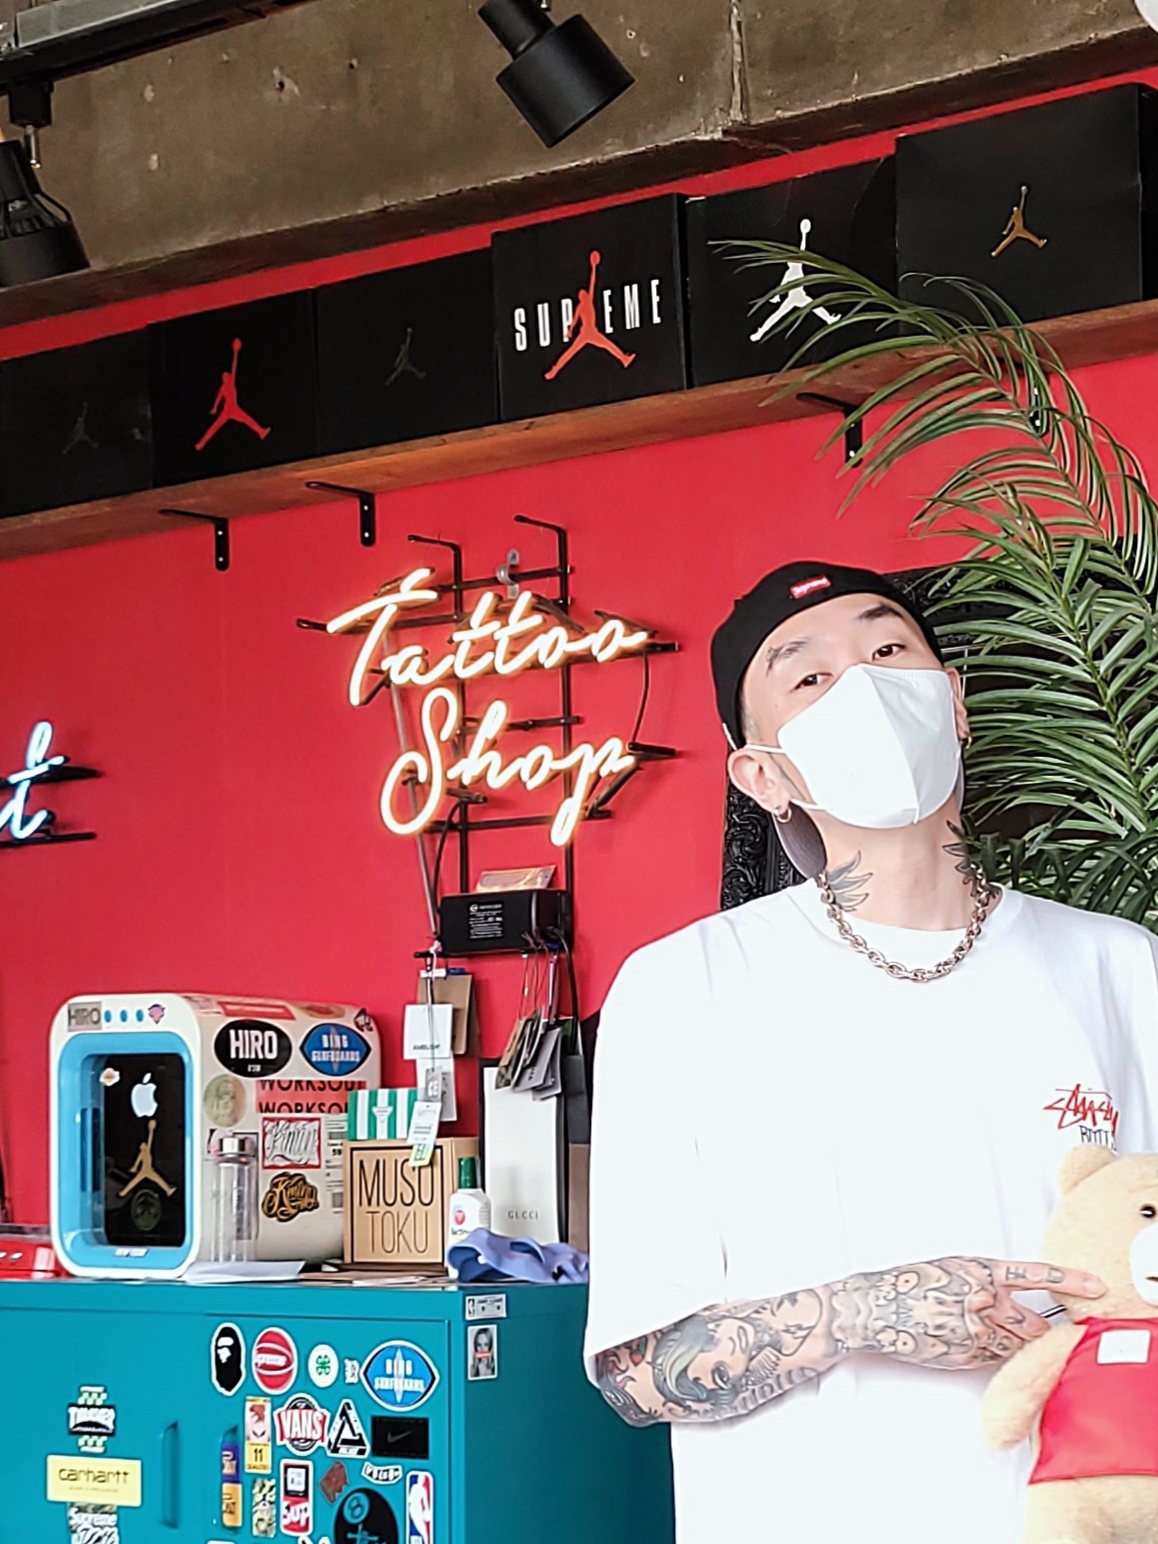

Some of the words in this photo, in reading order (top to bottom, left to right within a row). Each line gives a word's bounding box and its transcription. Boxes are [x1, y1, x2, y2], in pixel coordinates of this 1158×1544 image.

[513, 279, 661, 351] SUPEME
[325, 567, 648, 706] Tattoo
[380, 687, 635, 847] Shop
[228, 1028, 279, 1060] HIRO
[258, 1101, 349, 1114] WORKSO
[358, 1158, 435, 1208] MUSO
[365, 1210, 429, 1254] TOKU
[280, 1408, 324, 1440] VANS
[58, 1467, 130, 1485] carhartt
